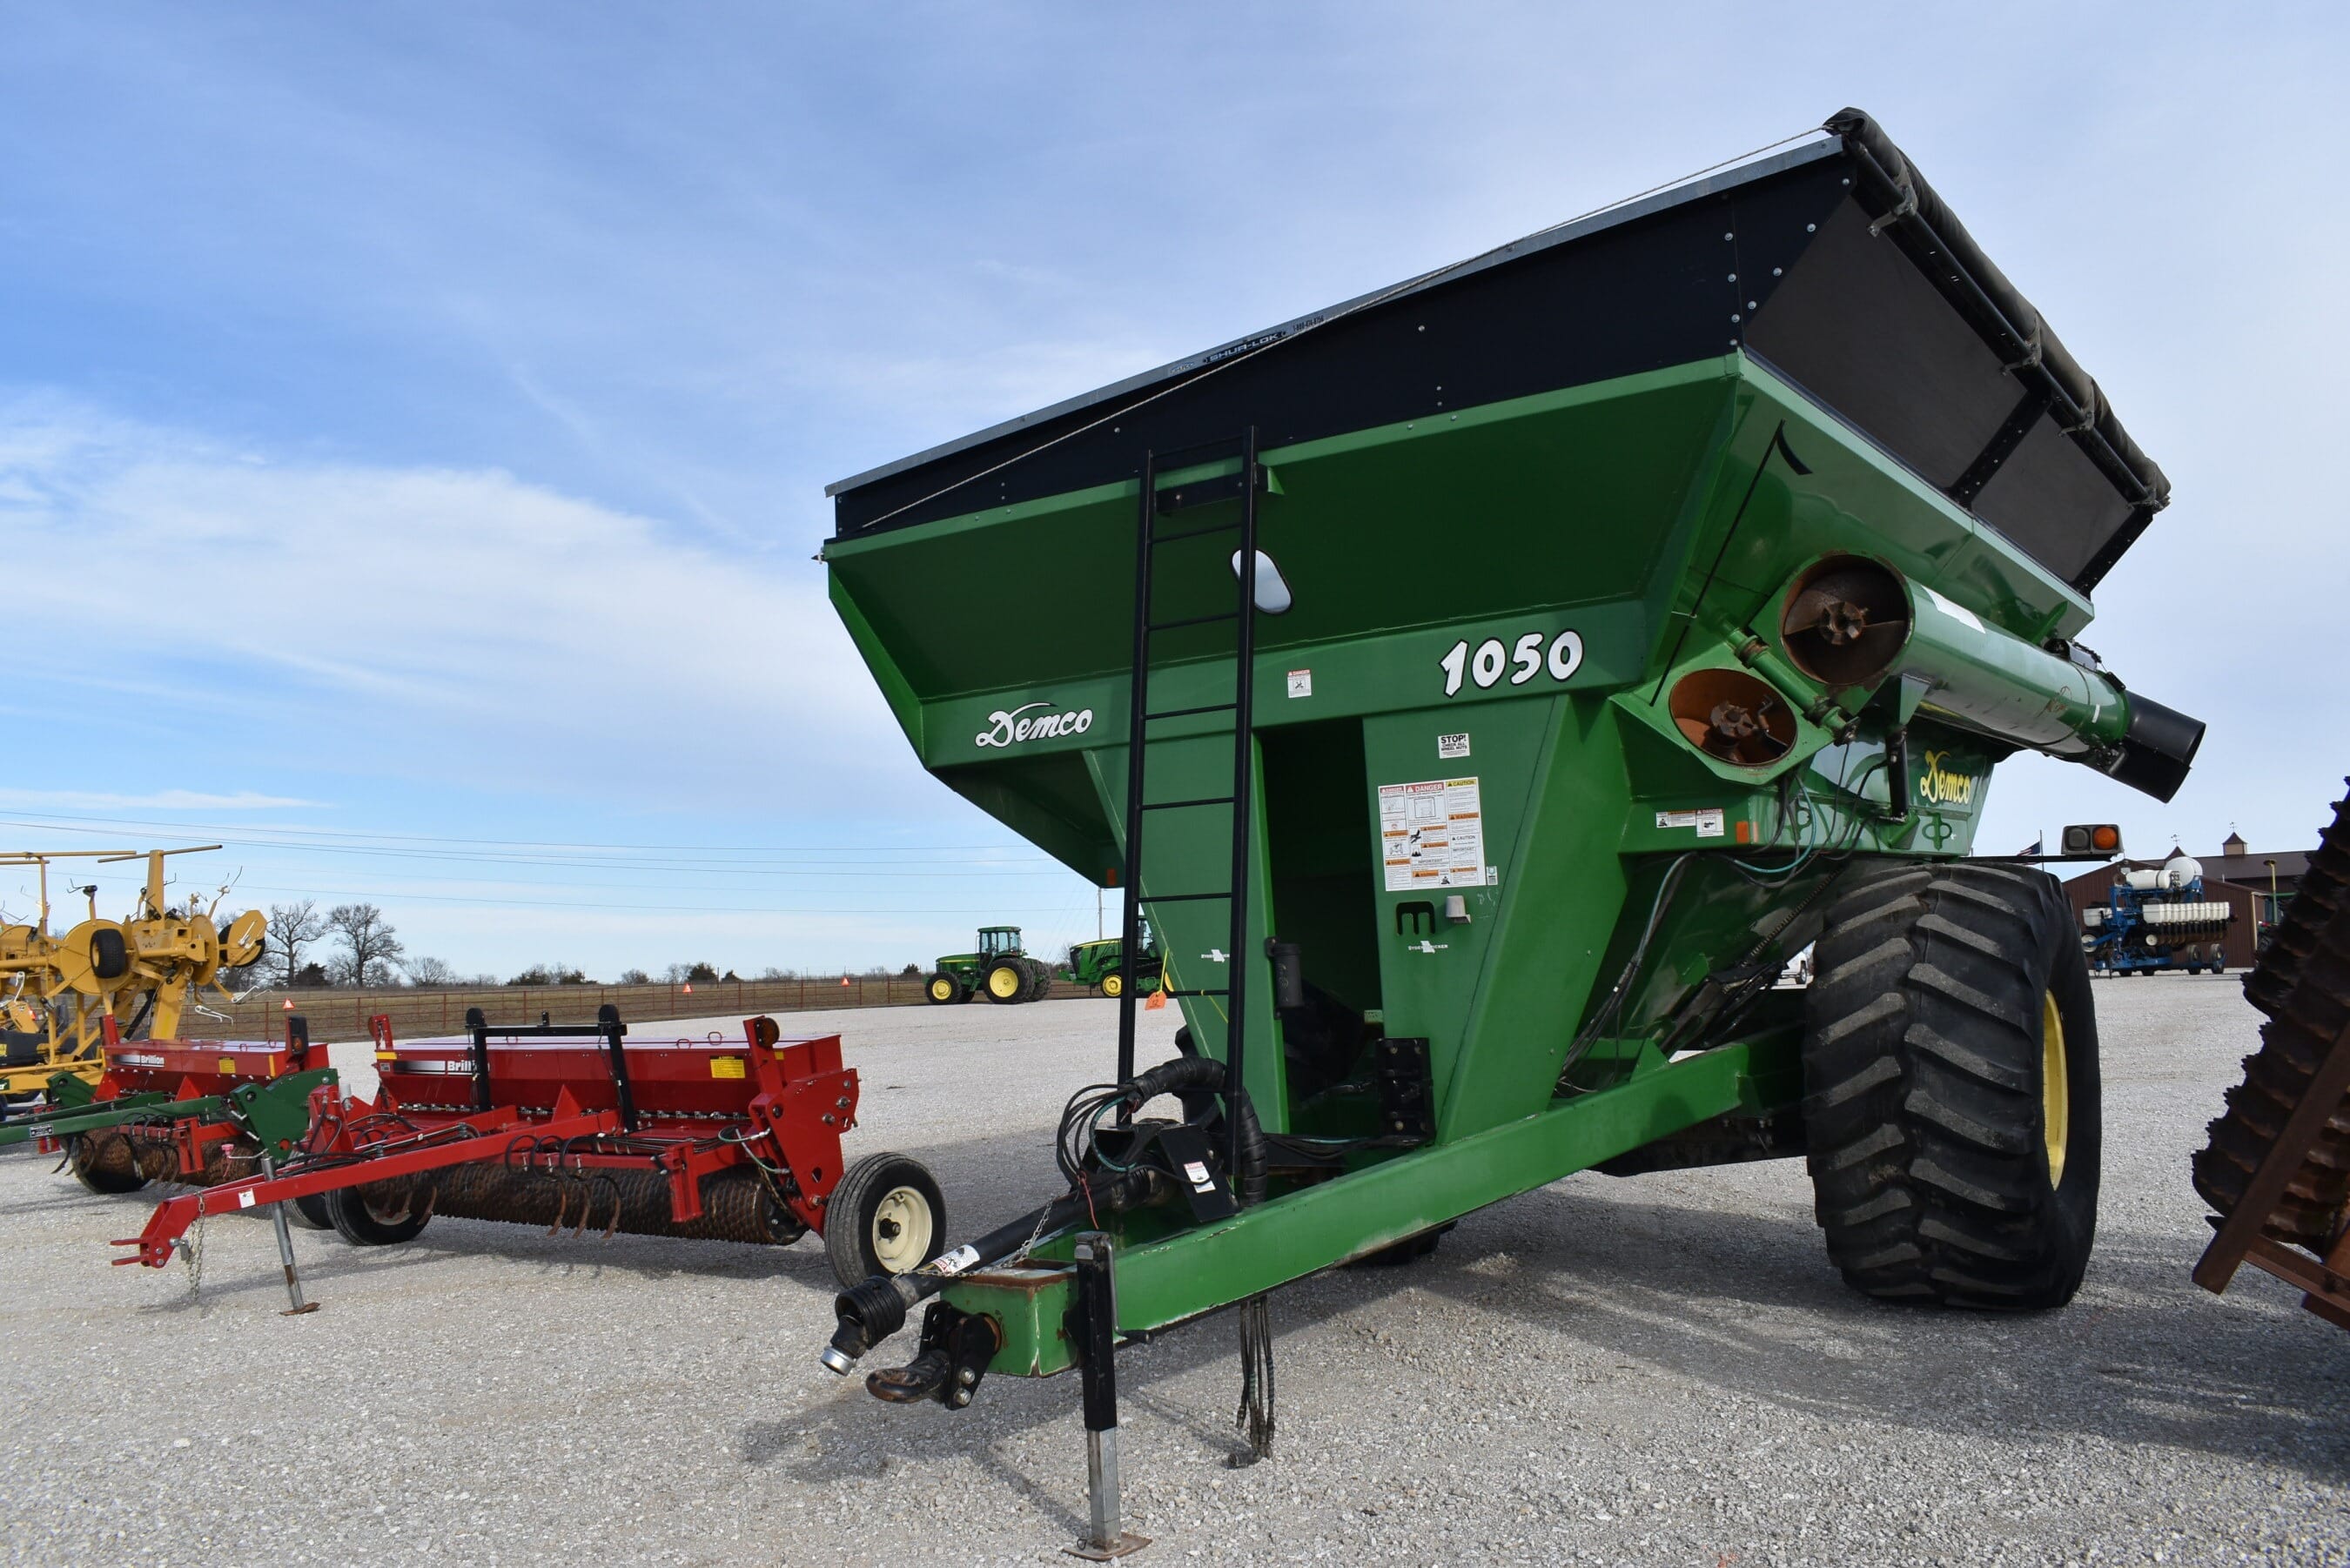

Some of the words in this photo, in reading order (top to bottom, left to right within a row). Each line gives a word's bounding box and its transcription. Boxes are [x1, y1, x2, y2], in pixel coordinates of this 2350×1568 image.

[1439, 629, 1584, 698] 1050
[975, 702, 1093, 747] Demco
[1441, 734, 1467, 744] STOP!
[1920, 750, 1971, 804] Demco
[1415, 783, 1442, 792] DANGER
[141, 1055, 164, 1065] Brillion
[447, 1059, 490, 1072] Brilli
